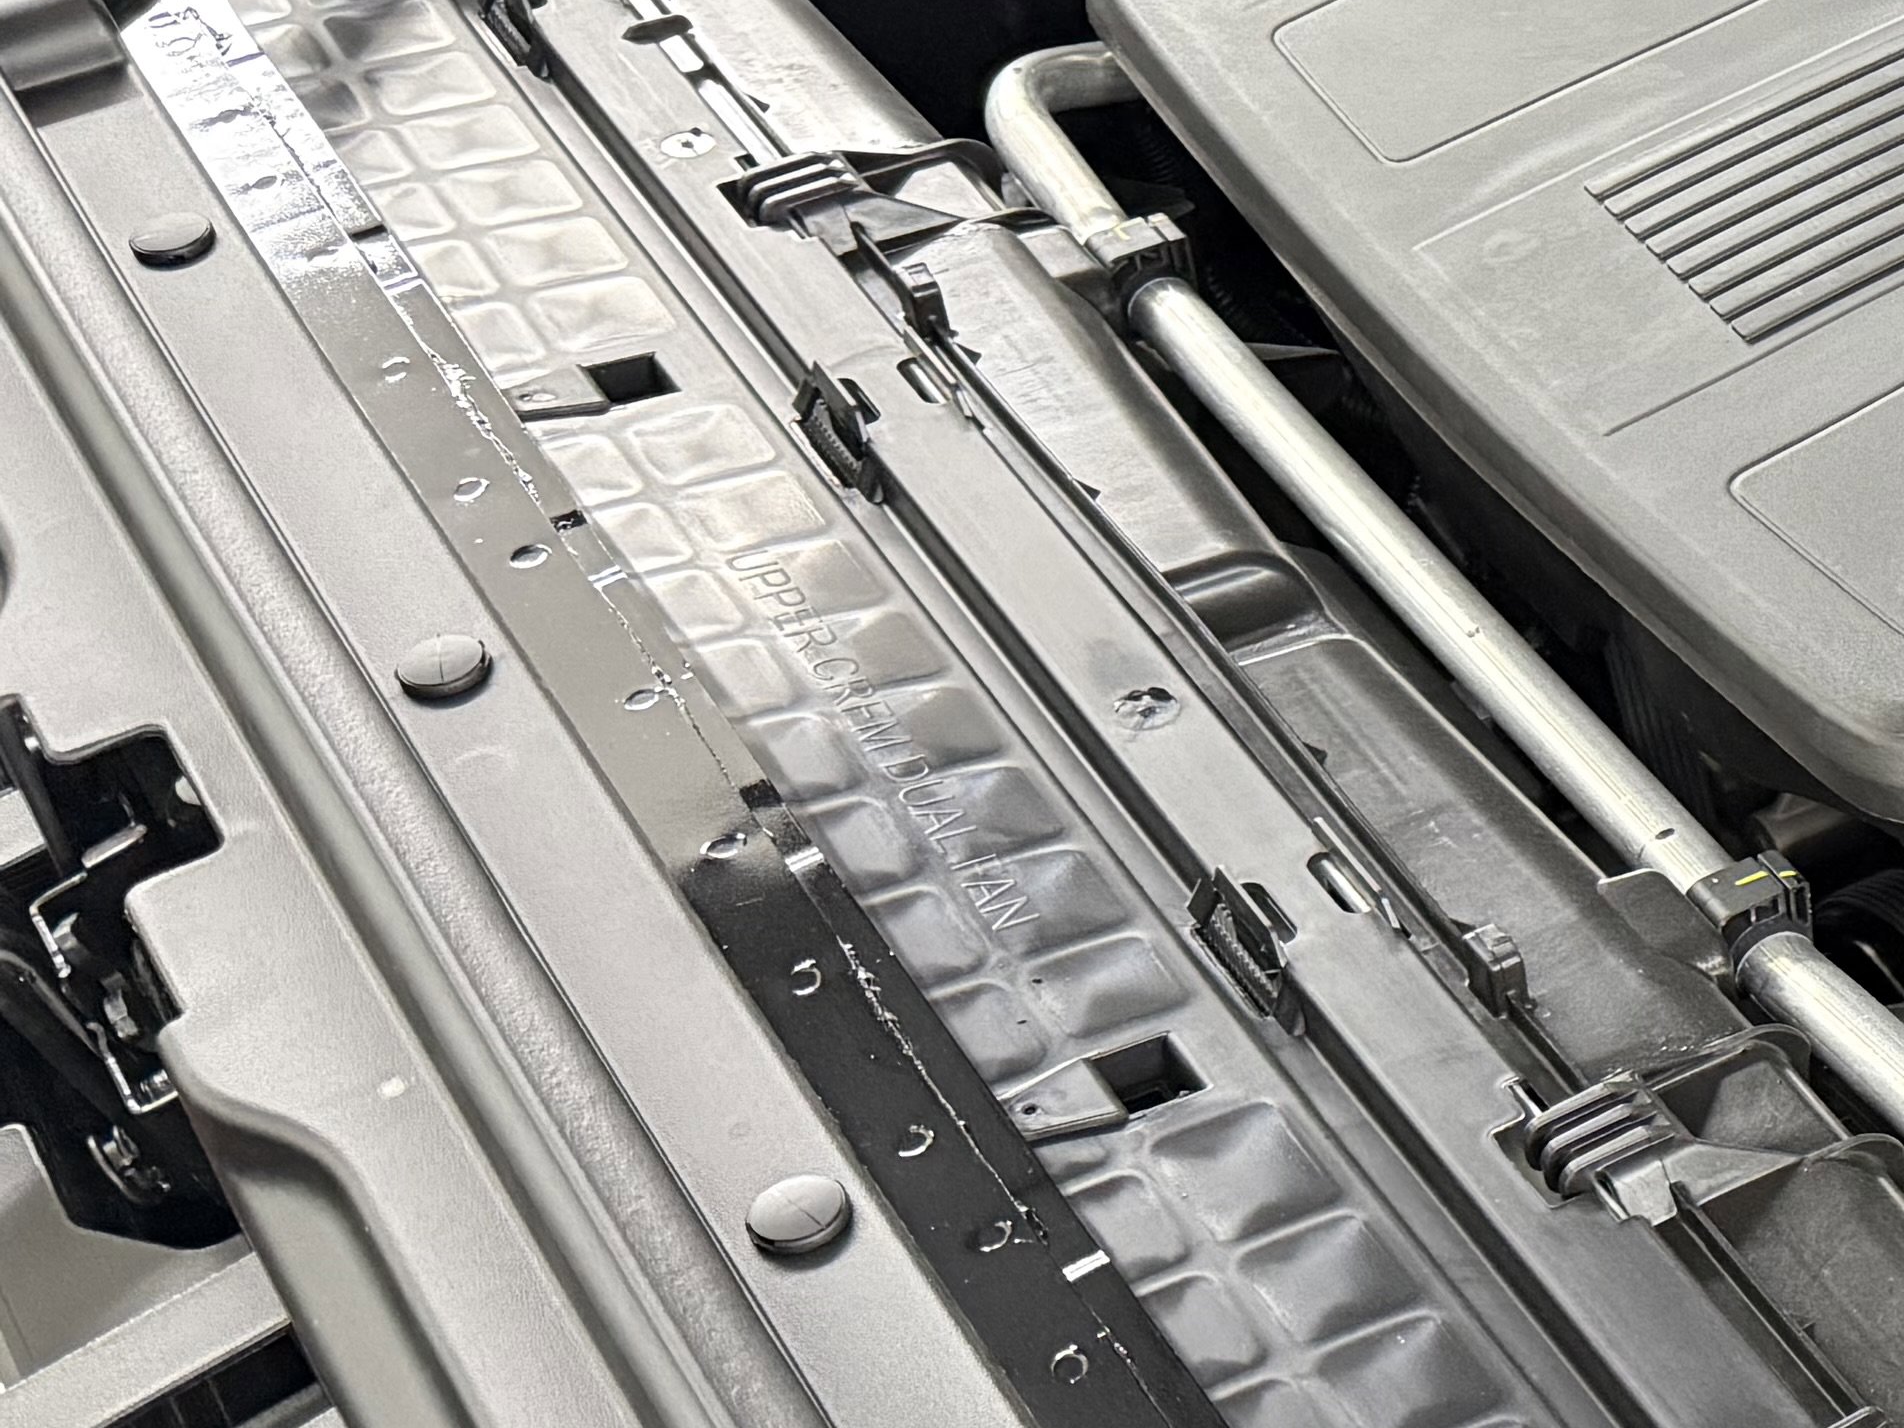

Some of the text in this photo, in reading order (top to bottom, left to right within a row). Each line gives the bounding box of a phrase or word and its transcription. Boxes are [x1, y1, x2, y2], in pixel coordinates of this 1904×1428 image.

[725, 550, 837, 653] UPPER
[878, 754, 977, 853] DUAL
[950, 854, 1041, 931] FAN
